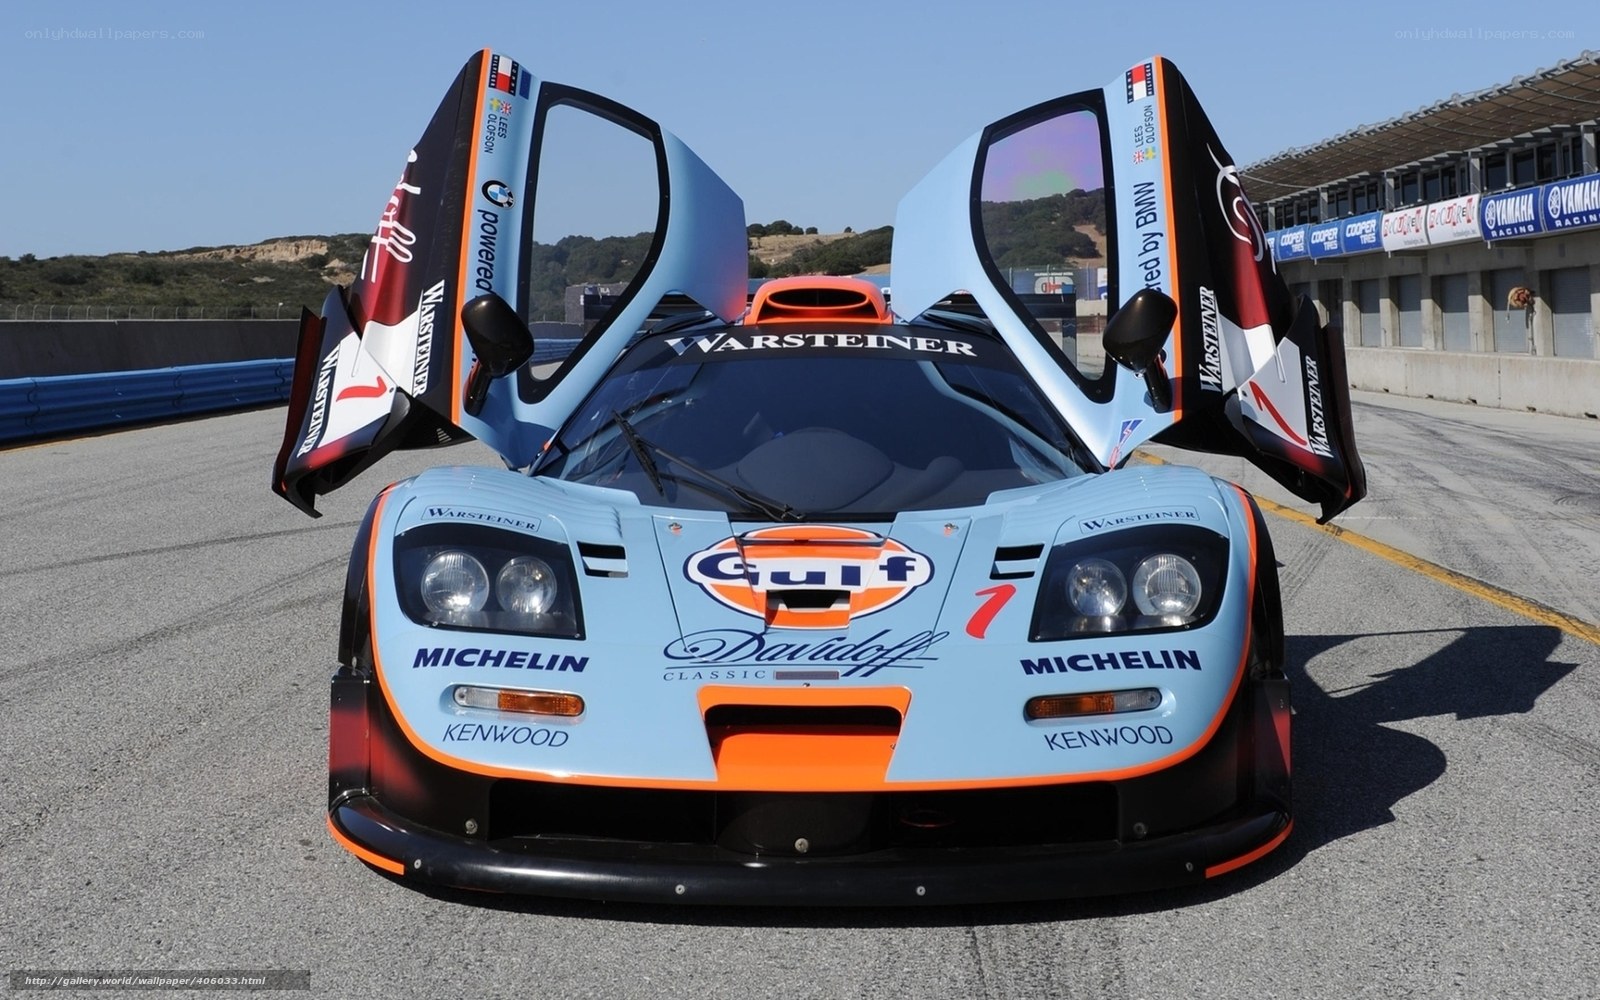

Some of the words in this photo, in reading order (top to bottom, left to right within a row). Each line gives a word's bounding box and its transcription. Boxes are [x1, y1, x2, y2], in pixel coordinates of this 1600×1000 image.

[484, 113, 497, 154] OLOFSON
[498, 116, 508, 139] LEES
[1134, 125, 1144, 148] LEES
[1144, 104, 1156, 144] OLOFSON
[1133, 182, 1157, 230] BMW
[1561, 179, 1600, 215] YAMAH
[1496, 194, 1535, 226] YAMAHA
[1555, 213, 1600, 227] RACIN
[1280, 230, 1305, 247] COOPER
[1311, 227, 1338, 245] COOPER
[1346, 219, 1376, 238] COOPER
[1360, 233, 1376, 245] TIRES
[1491, 224, 1535, 238] RACING
[475, 209, 499, 296] powered
[1138, 232, 1164, 257] by
[1324, 240, 1338, 251] TIRES
[413, 279, 445, 398] WARSTEINER
[664, 333, 978, 357] WARSTEINER
[1199, 286, 1223, 392] WARSTEINER
[297, 344, 340, 458] WARSTEINER
[336, 375, 387, 402] 1
[1249, 380, 1308, 446] 1
[1305, 355, 1334, 458] WARSTEINER
[428, 508, 536, 531] WARSTEINER
[1083, 510, 1196, 531] WARSTEINER
[697, 551, 917, 587] Gulf
[966, 583, 1017, 639] 1
[412, 648, 590, 673] MICHELIN
[663, 628, 950, 677] Davidoff
[1020, 650, 1202, 675] MICHELIN
[663, 670, 767, 681] CLASSIC
[442, 723, 569, 748] KENWOOD
[1044, 725, 1173, 751] KENWOOD
